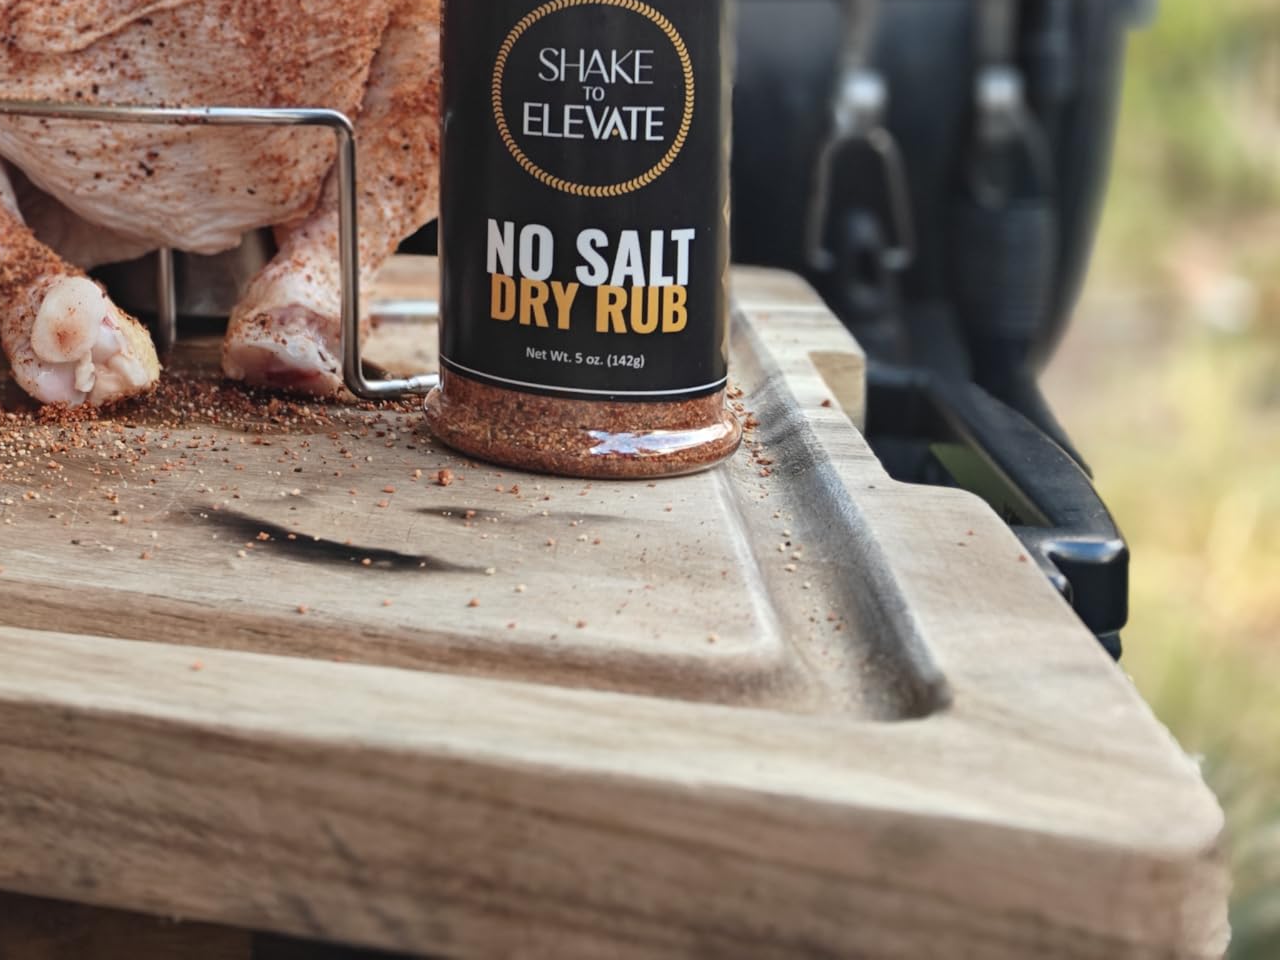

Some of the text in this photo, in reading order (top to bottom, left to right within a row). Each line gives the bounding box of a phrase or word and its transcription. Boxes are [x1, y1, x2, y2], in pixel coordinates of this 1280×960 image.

[538, 47, 654, 85] SHAKE
[583, 86, 605, 102] TO
[522, 102, 665, 140] ELEVATE
[486, 218, 696, 287] NO SALT
[490, 273, 688, 334] DRY RUB
[526, 347, 645, 369] Net Wt. 5 oz. (142g)
